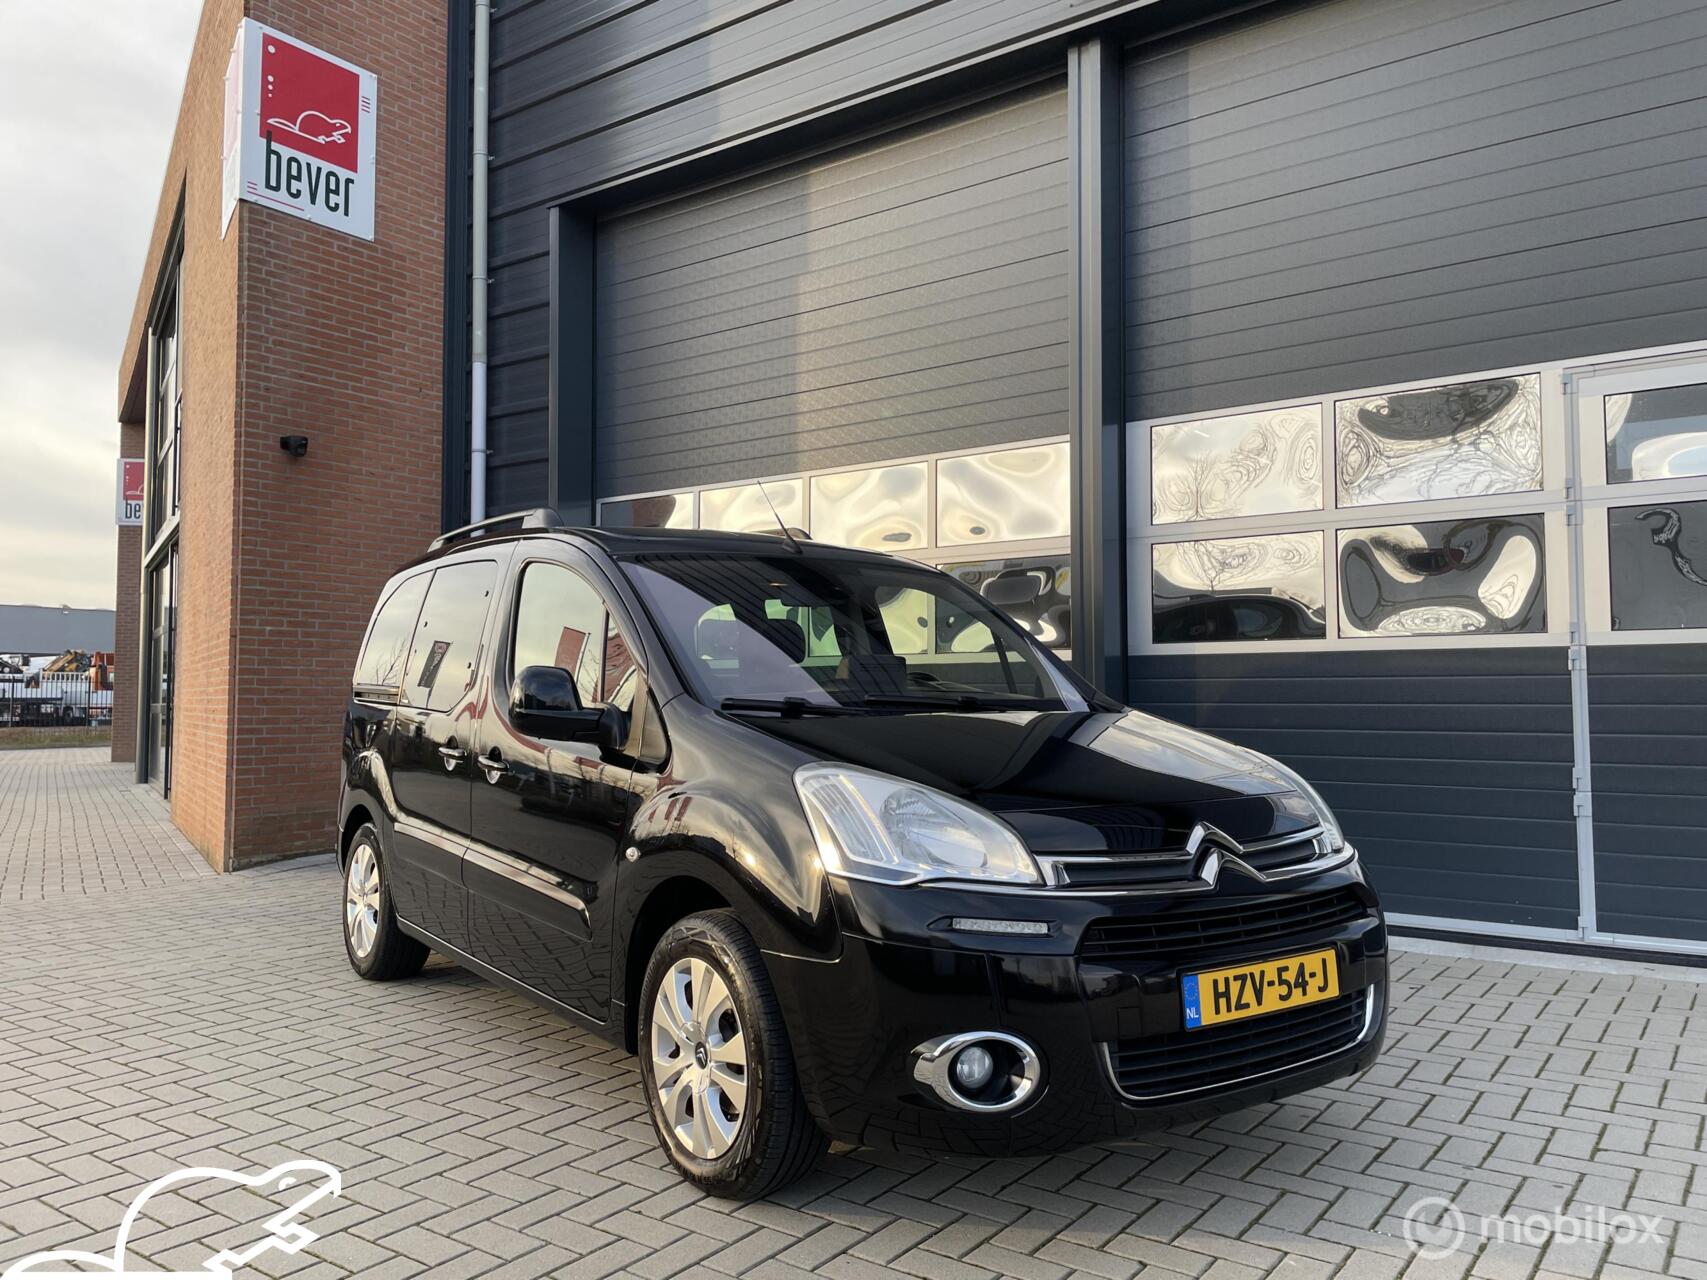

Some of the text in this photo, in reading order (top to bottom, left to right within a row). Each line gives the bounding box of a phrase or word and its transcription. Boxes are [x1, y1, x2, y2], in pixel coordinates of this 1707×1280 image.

[264, 130, 355, 217] bever
[125, 497, 144, 519] be
[1212, 958, 1329, 1015] HZV-54-J
[1186, 1007, 1199, 1019] NL
